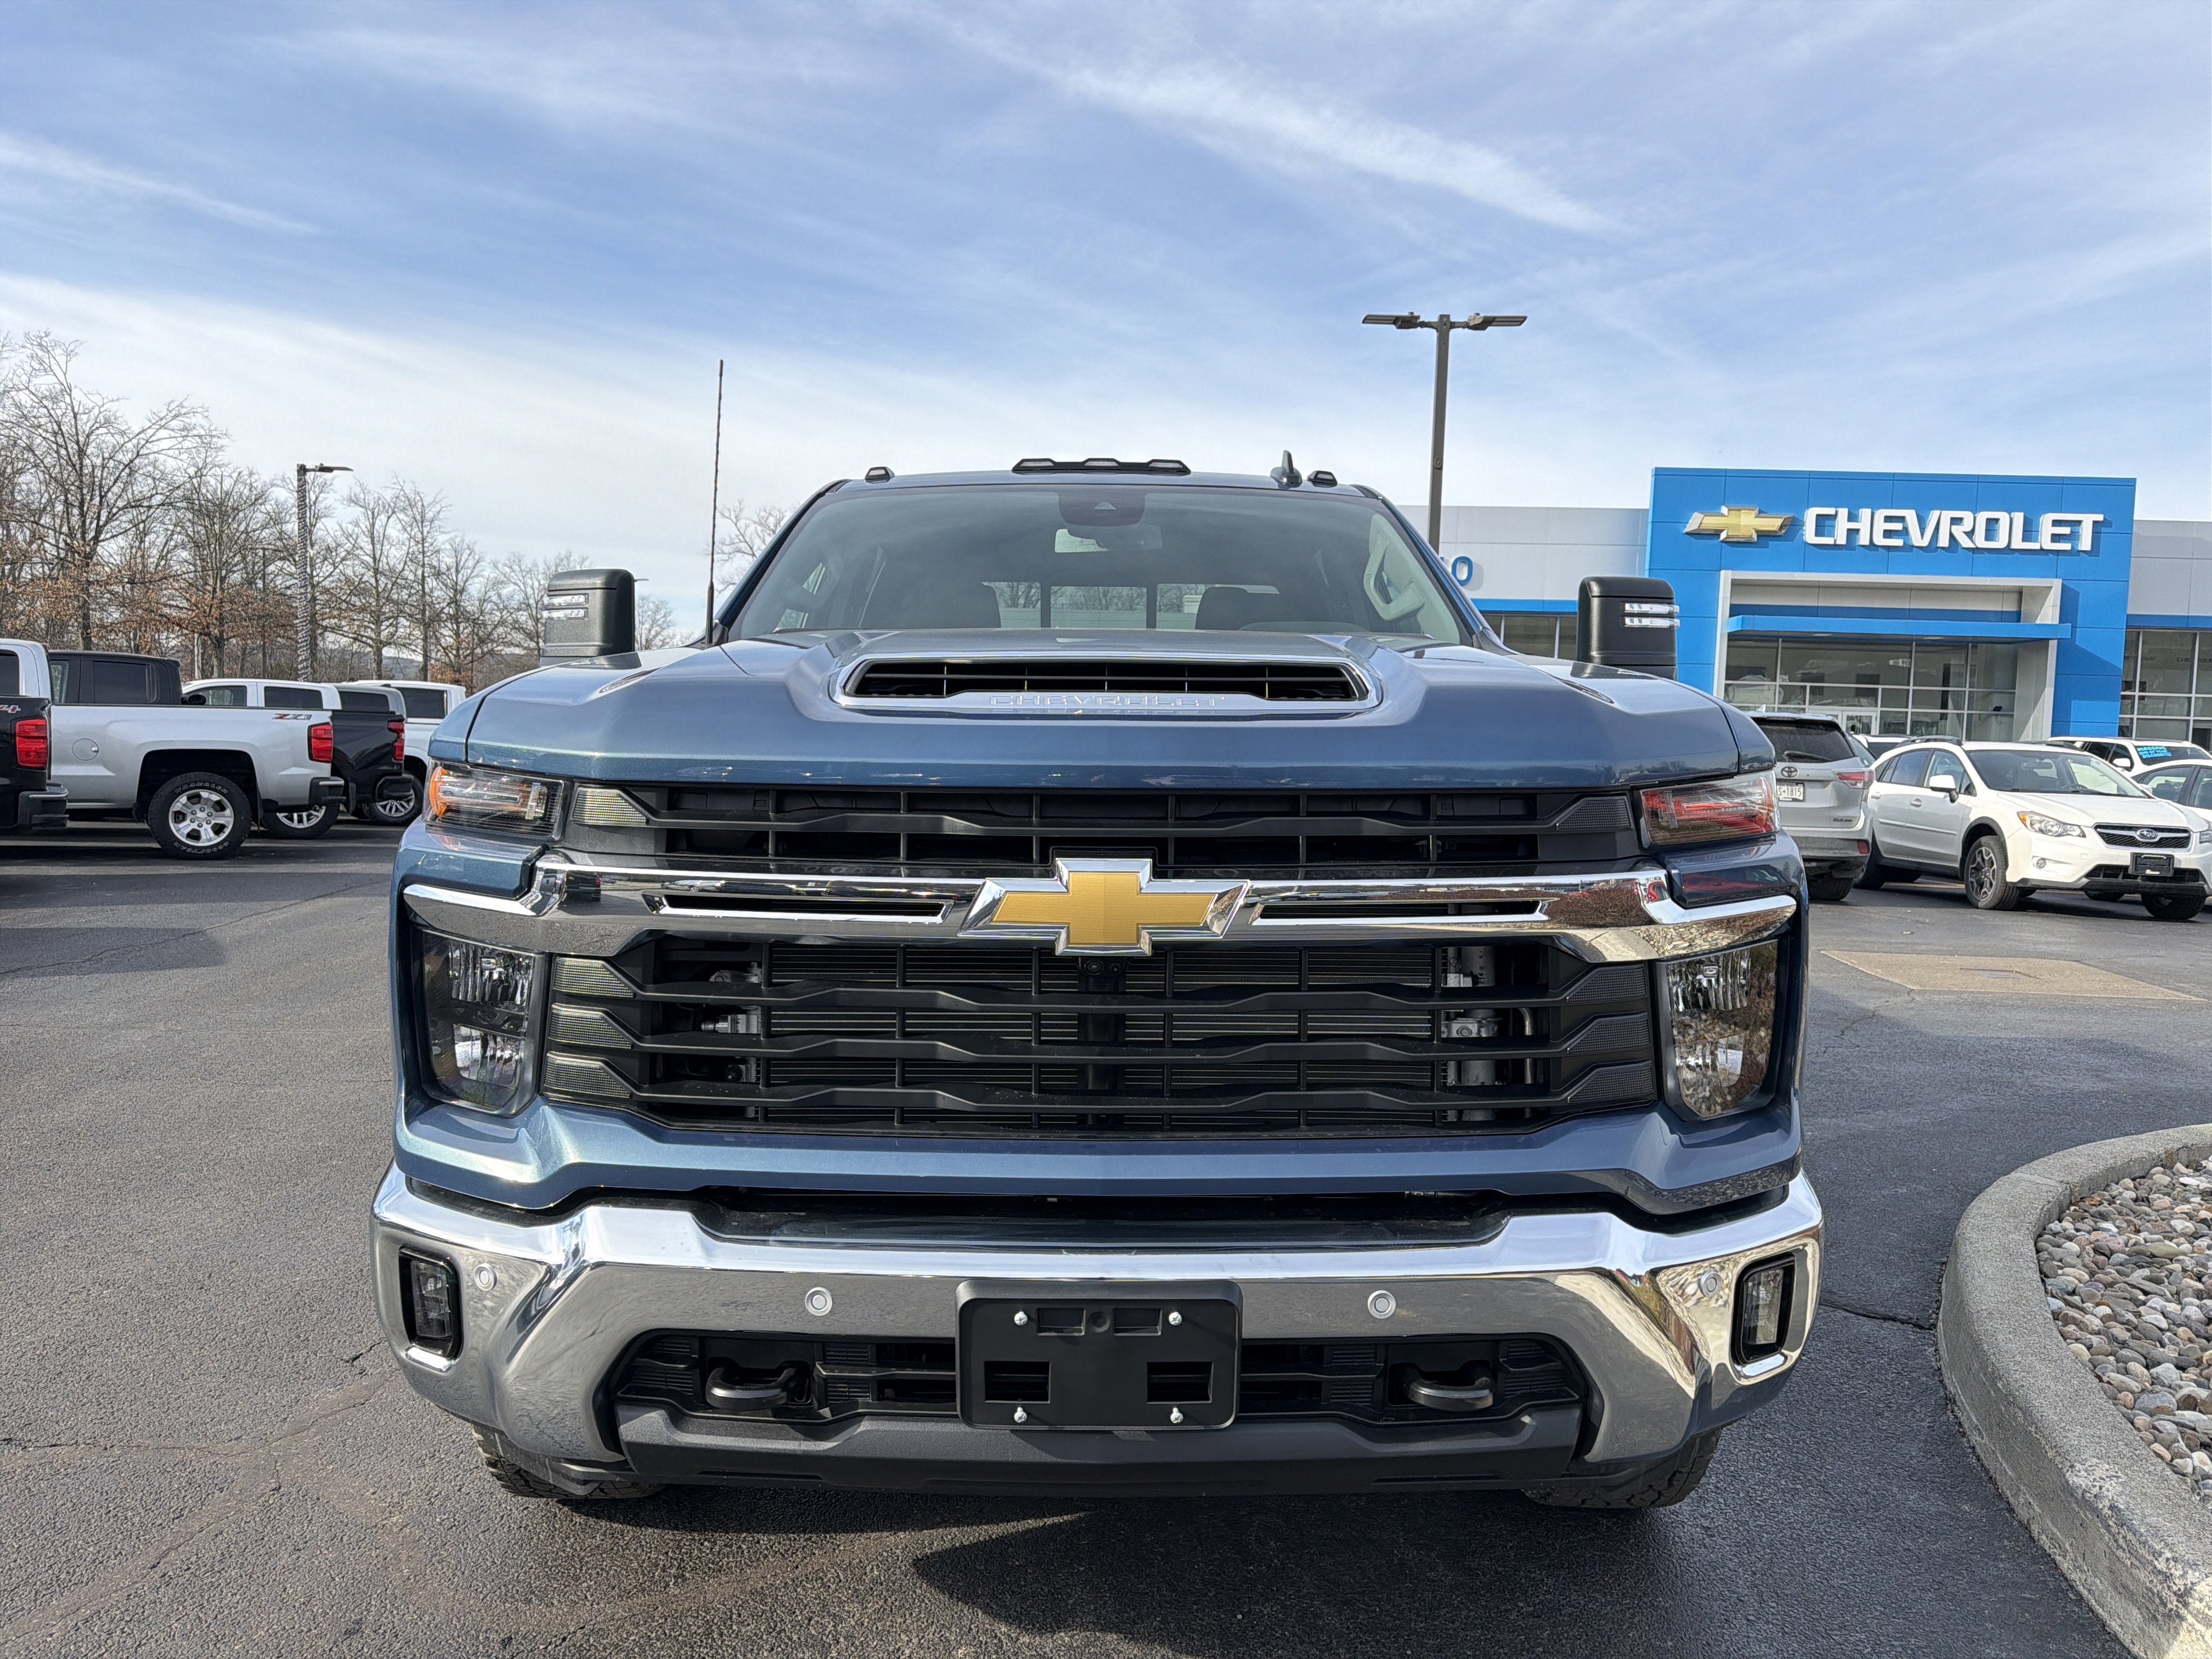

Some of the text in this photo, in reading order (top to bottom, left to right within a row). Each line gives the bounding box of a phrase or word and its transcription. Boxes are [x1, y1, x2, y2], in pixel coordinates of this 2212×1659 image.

[1803, 506, 2104, 551] CHEVROLET
[1440, 556, 1473, 586] O
[989, 695, 1225, 707] CHEVROLET
[174, 782, 229, 794] WRANGLER
[173, 841, 229, 854] GOODYEAR
